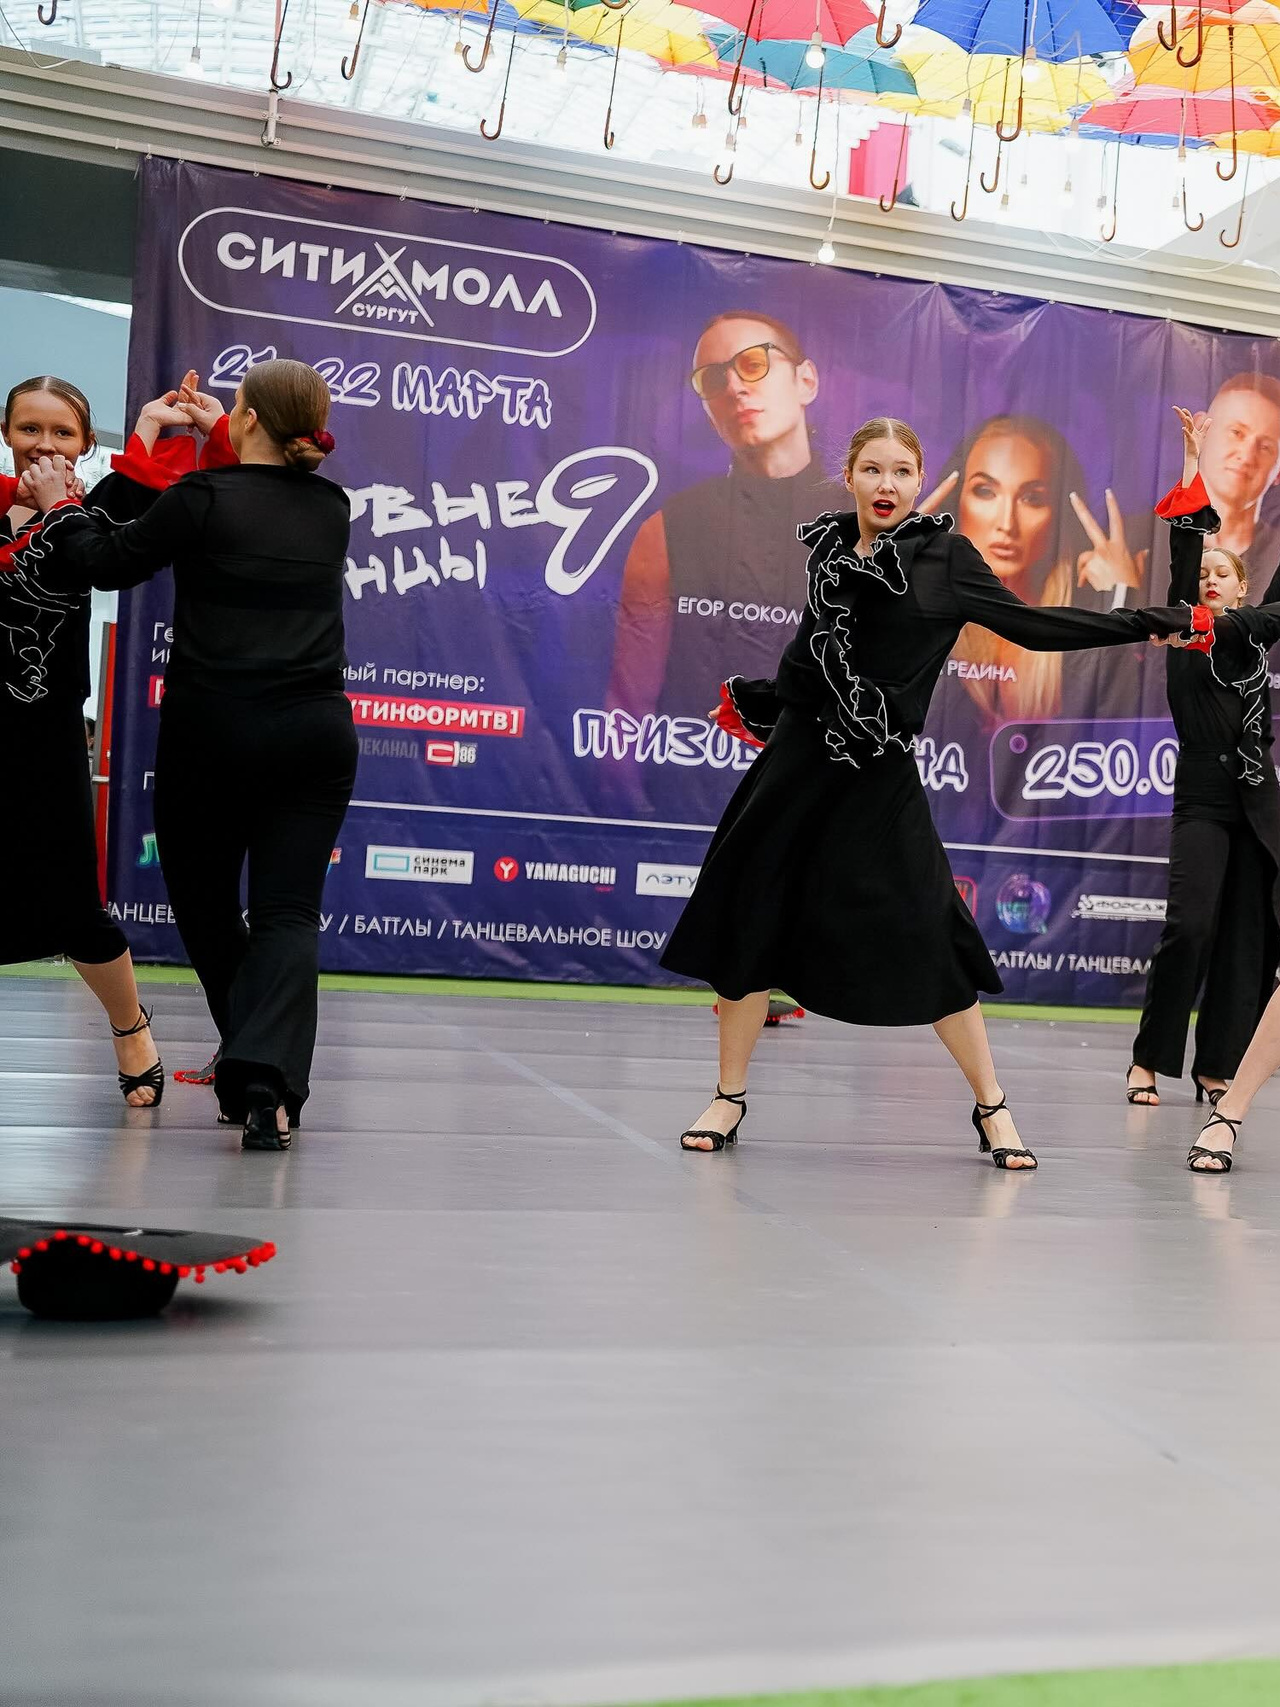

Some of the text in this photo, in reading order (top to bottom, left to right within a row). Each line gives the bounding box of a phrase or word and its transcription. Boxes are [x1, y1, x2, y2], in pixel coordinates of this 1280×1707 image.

[217, 231, 563, 318] СИТИ МОЛЛ
[351, 302, 419, 325] СУРГУТ
[392, 361, 552, 430] МАРТА
[677, 596, 804, 626] ЕГОР СОКОЛ
[383, 667, 486, 695] партнер:
[946, 659, 1018, 683] РЕДИНА
[1021, 737, 1180, 801] 250.0
[525, 861, 617, 885] YAMAGUCHI
[354, 914, 432, 938] БАТТЛЫ
[452, 919, 612, 947] ТАНЦЕВАЛЬНОЕ
[616, 929, 668, 950] ШОУ
